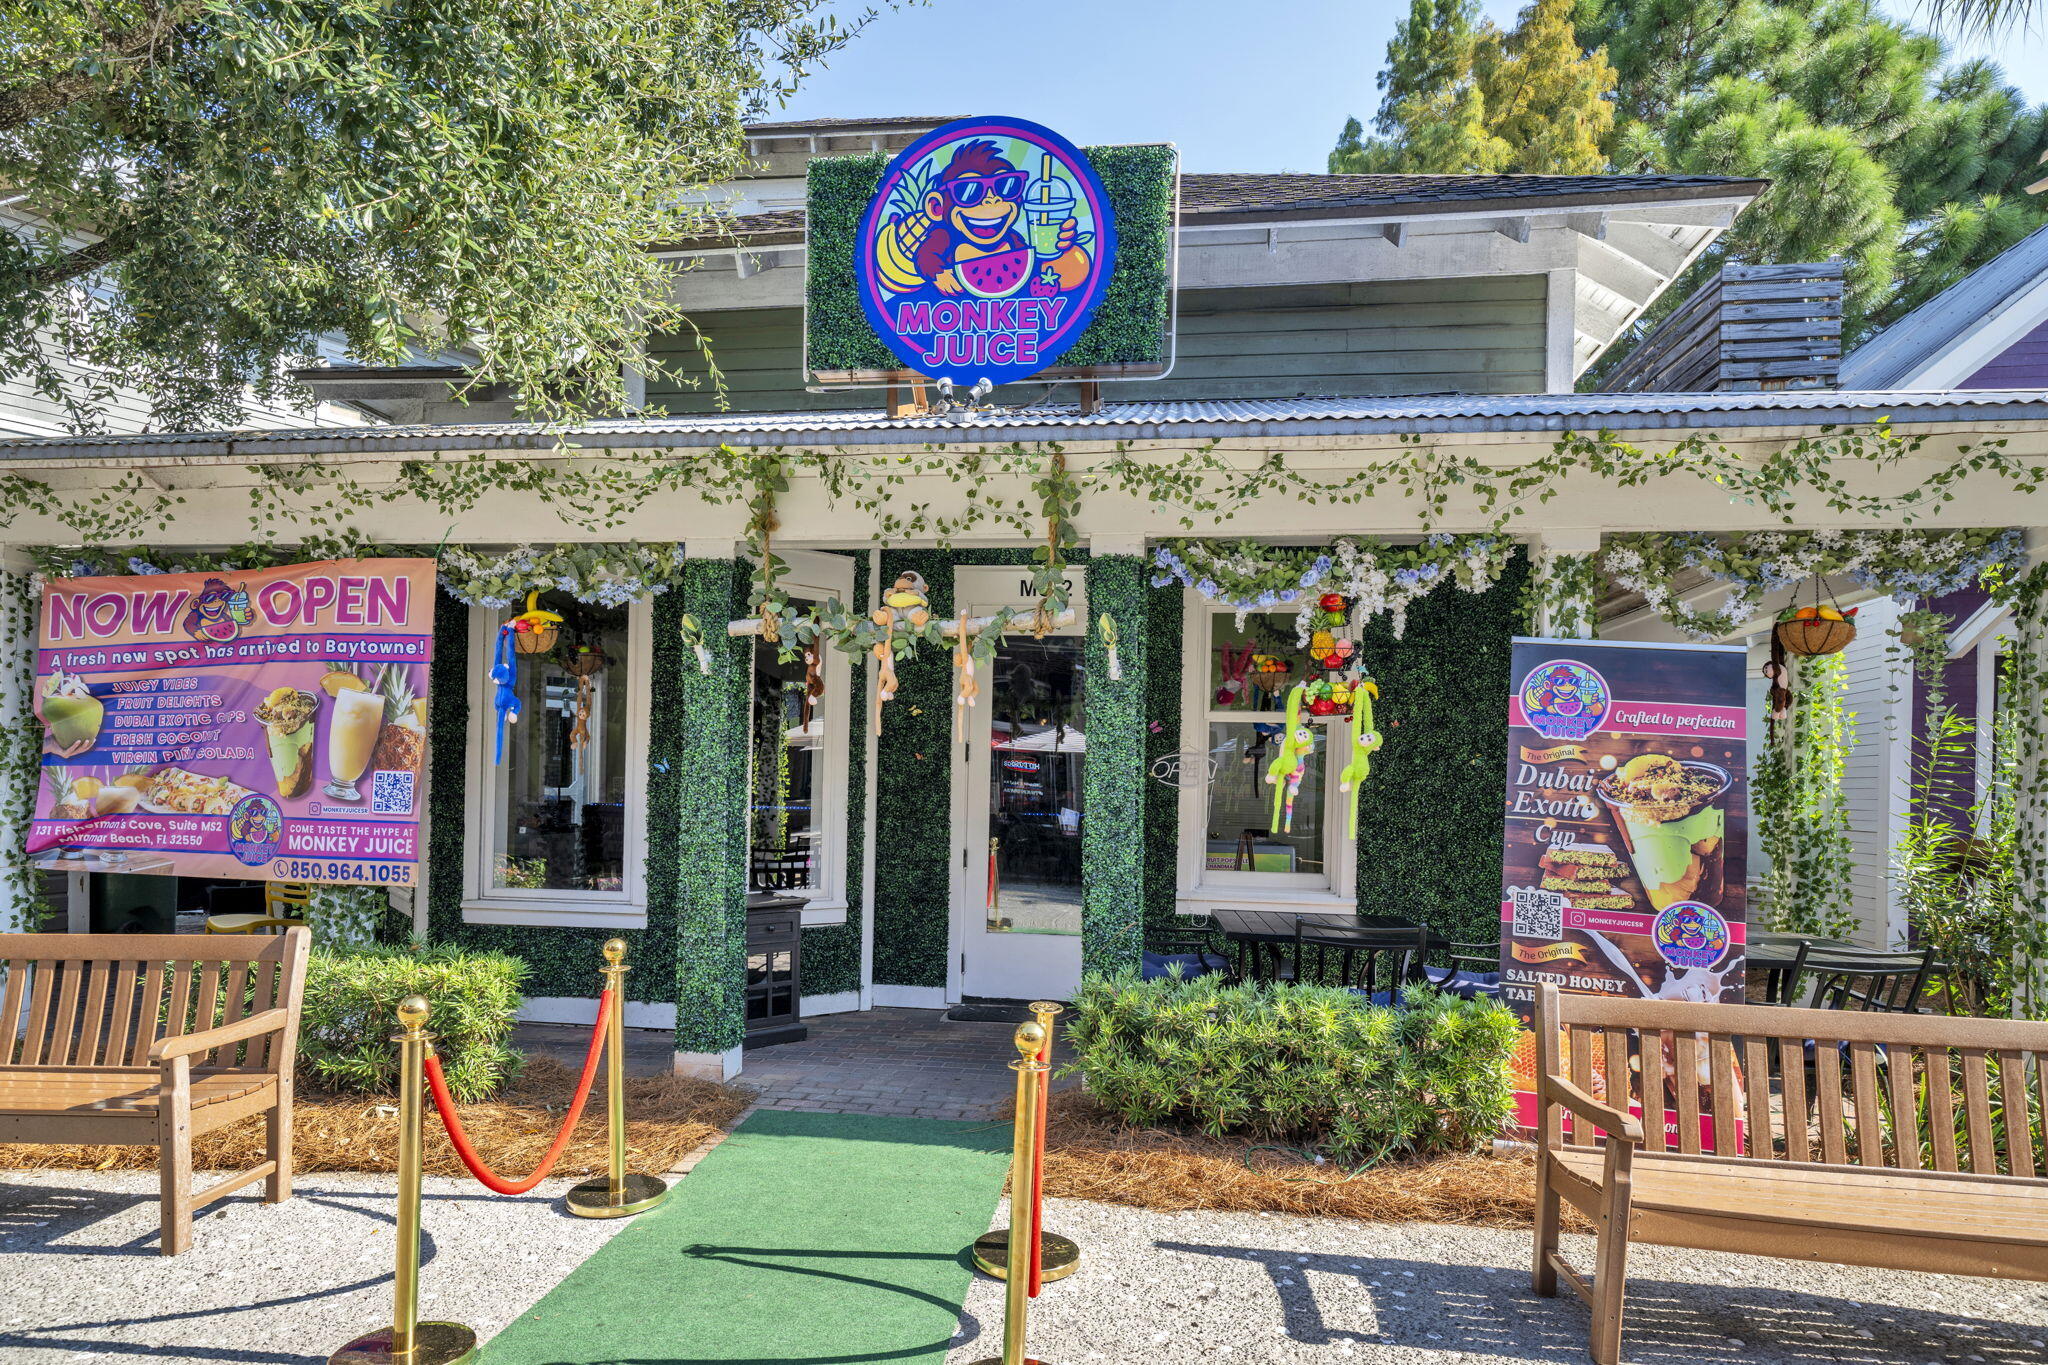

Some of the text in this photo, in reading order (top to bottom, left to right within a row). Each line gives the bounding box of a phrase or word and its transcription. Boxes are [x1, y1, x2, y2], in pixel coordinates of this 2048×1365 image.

[897, 297, 1068, 335] MONKEY
[922, 333, 1038, 367] JUICE
[1020, 580, 1072, 597] M2
[48, 576, 409, 641] NOW OPEN
[50, 639, 425, 668] A fresh new spot has arrived to Baytowne!
[112, 677, 199, 693] JUICY VIBES
[117, 694, 223, 710] FRUIT DELIGHTS
[114, 714, 155, 728] DUBAI
[158, 713, 212, 726] EXOTIC
[1533, 714, 1596, 728] MONKEY
[1615, 710, 1736, 731] Crafted to perfection
[113, 733, 153, 746] FRESH
[1543, 725, 1585, 739] JUICE
[112, 751, 157, 764] VIRGIN
[1526, 748, 1575, 761] The Original
[1514, 763, 1595, 791] Dubai
[1512, 790, 1598, 819] Exotic
[35, 825, 52, 836] 131
[129, 819, 166, 831] Cove,
[169, 821, 197, 831] Suite
[201, 821, 222, 832] MS2
[289, 824, 413, 837] COME TASTE THE HYPE AT
[1535, 824, 1576, 847] Cup
[110, 833, 153, 845] Beach,
[169, 835, 203, 846] 32550
[288, 835, 413, 855] MONKEY JUICE
[235, 843, 276, 854] MONKEY
[240, 852, 269, 863] JUICE
[290, 861, 411, 883] 850.964.1055
[1588, 917, 1644, 928] MONKEYJUICESR
[1519, 946, 1573, 960] The Original
[1664, 946, 1718, 960] MONKEY
[1673, 956, 1709, 968] JUICE
[1506, 968, 1626, 993] SALTED HONEY
